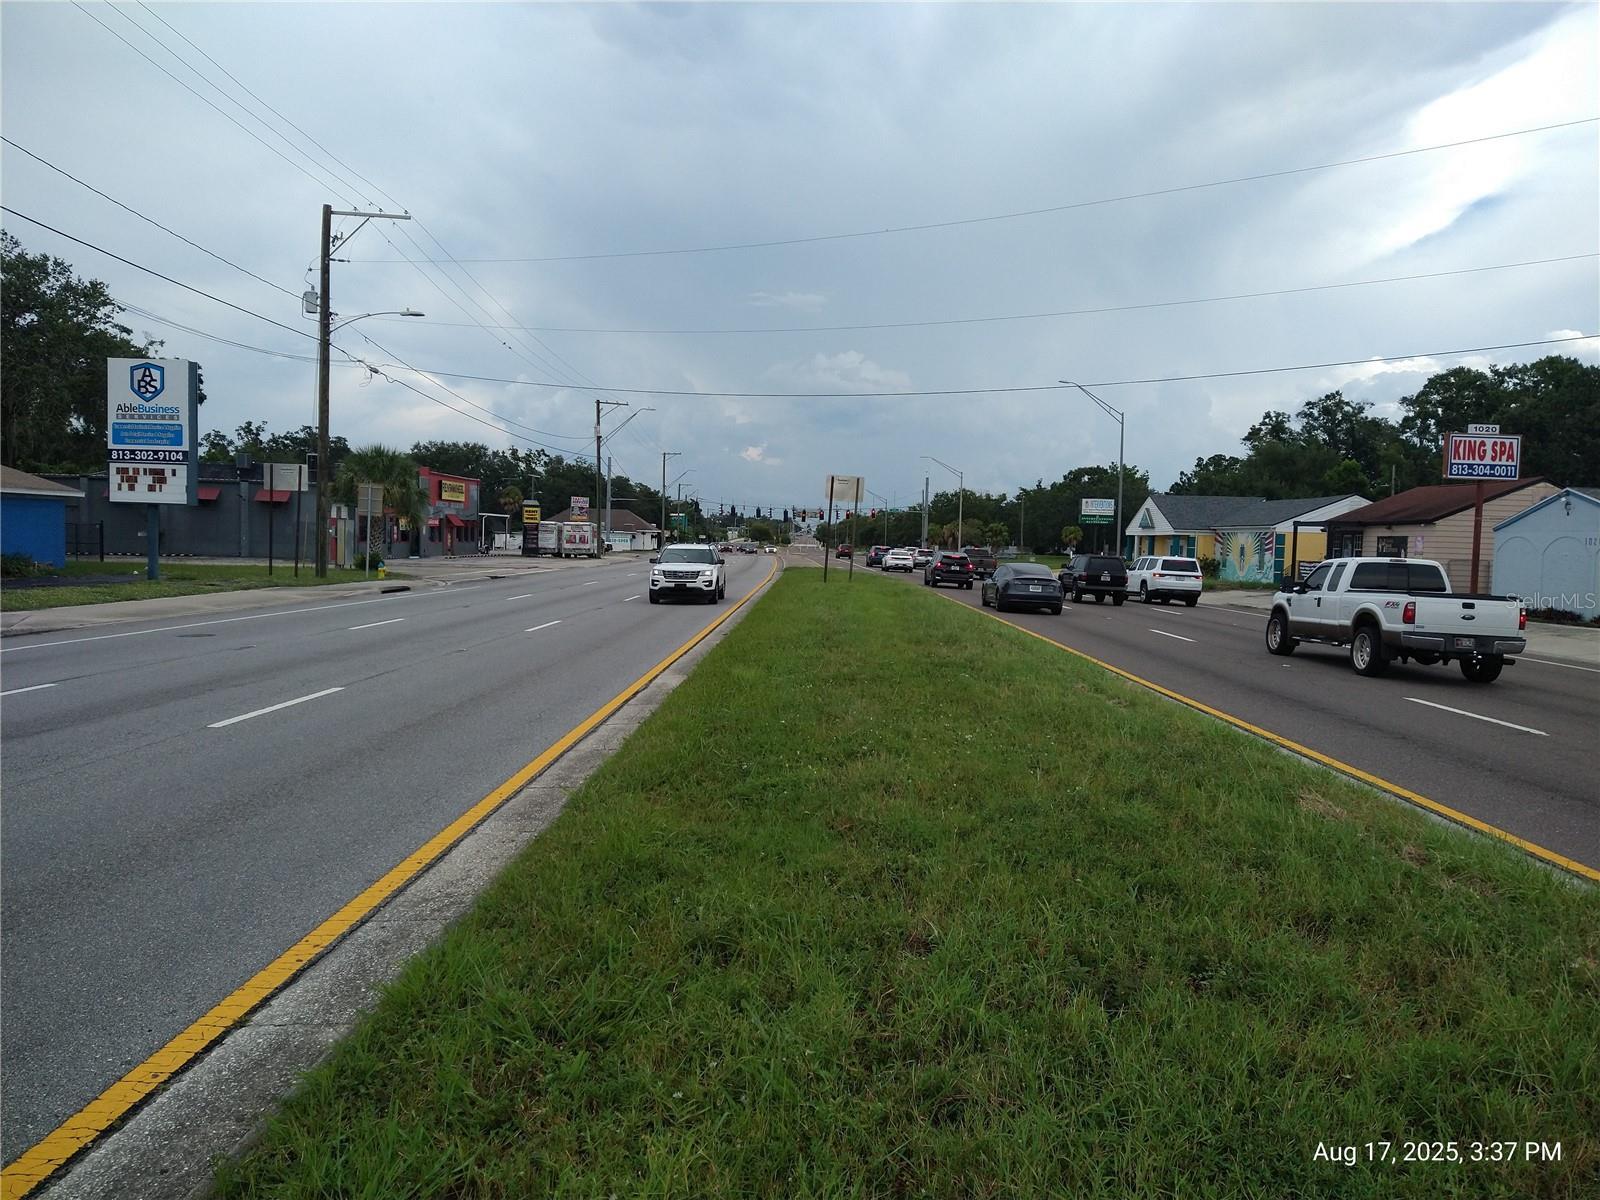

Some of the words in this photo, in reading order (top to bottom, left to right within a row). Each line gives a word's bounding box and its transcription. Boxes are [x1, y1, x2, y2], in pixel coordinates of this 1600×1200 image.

[111, 450, 183, 461] 813-302-9104
[1453, 440, 1487, 461] KING
[1491, 440, 1515, 462] SPA
[1452, 464, 1515, 476] 813-304-0011
